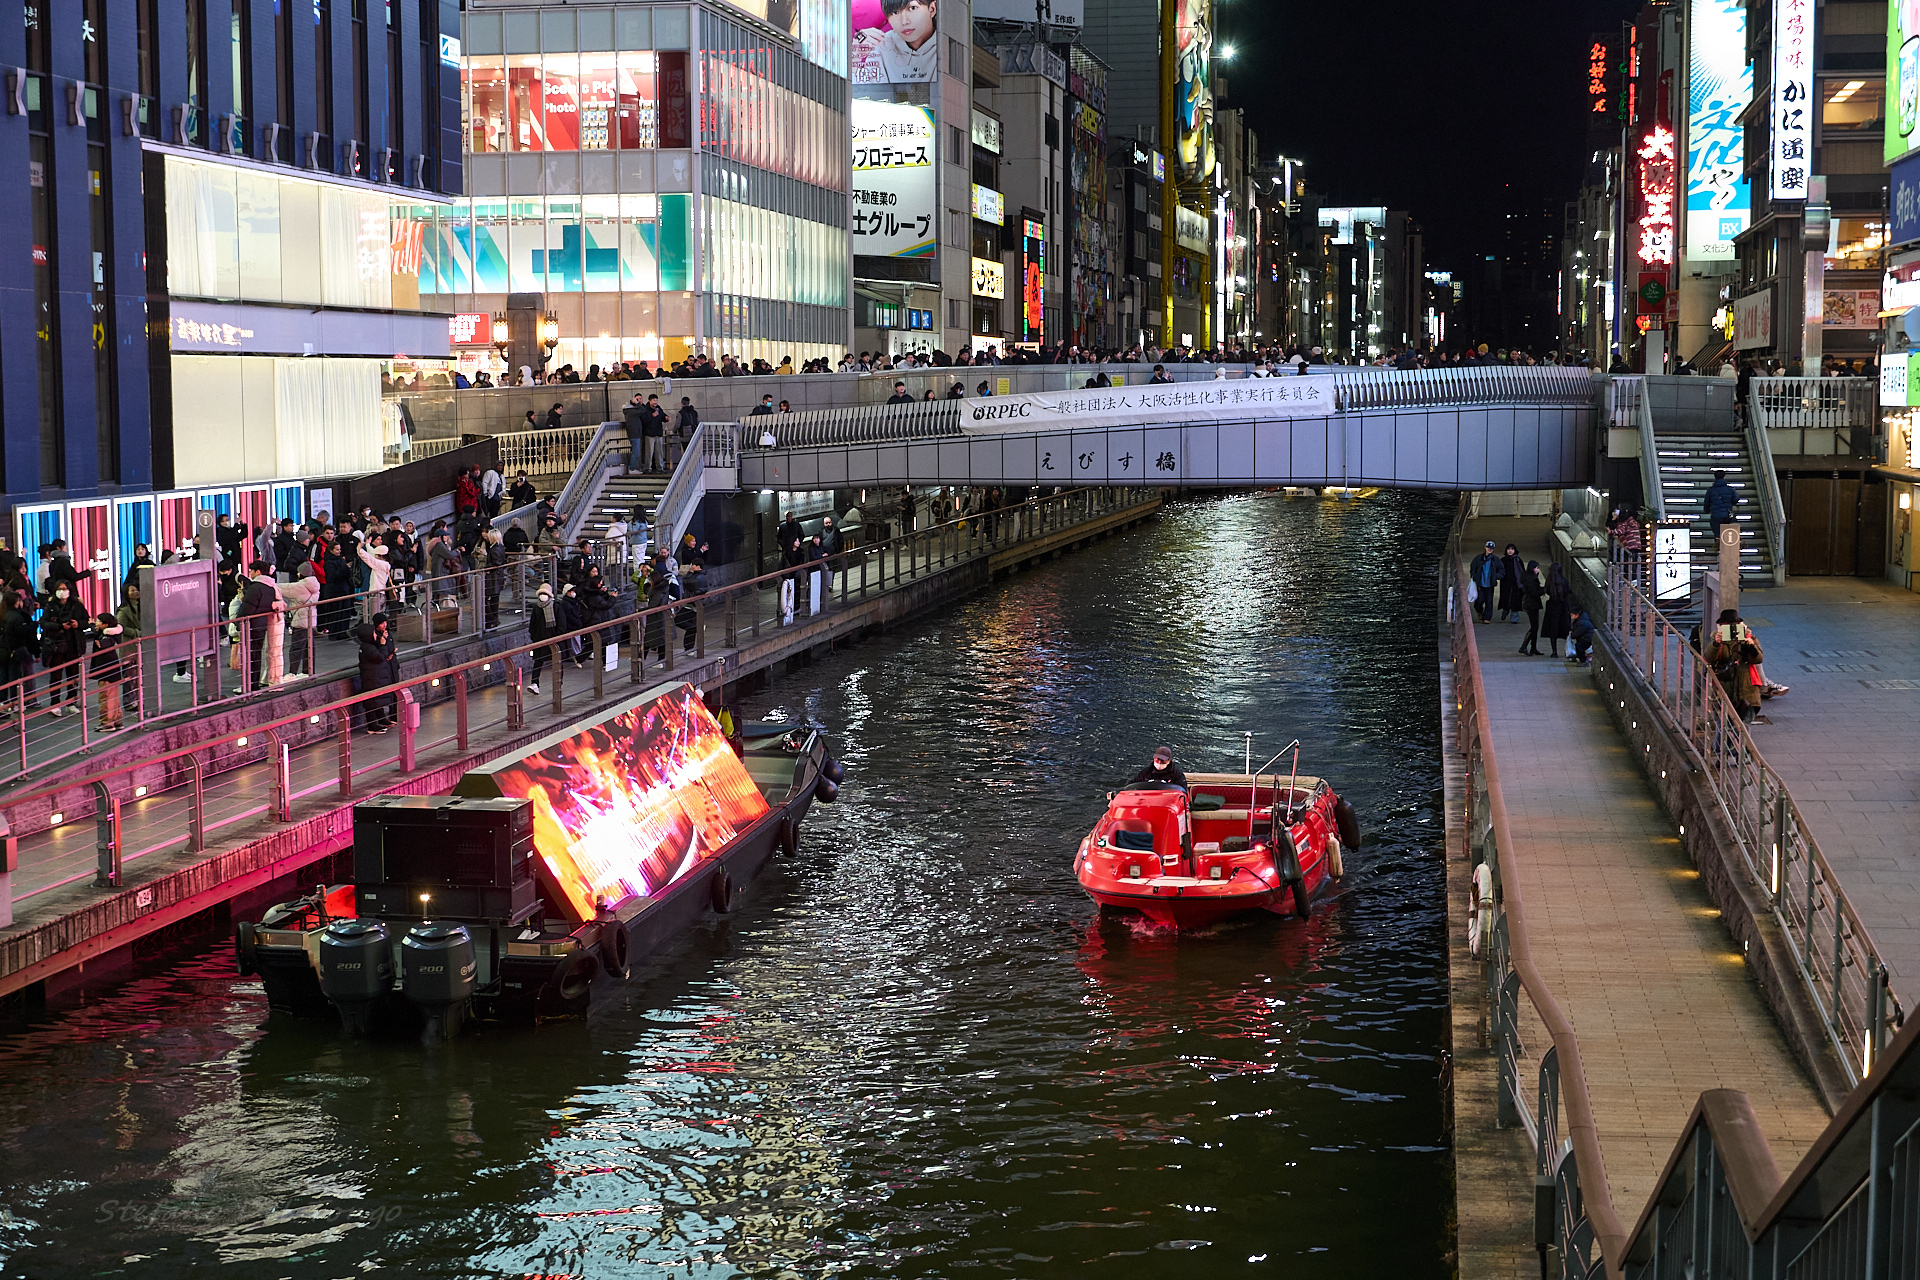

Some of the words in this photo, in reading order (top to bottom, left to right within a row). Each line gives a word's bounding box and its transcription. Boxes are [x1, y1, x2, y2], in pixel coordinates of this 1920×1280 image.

[545, 102, 576, 113] Photo
[1781, 79, 1806, 190] かに道楽
[853, 189, 897, 207] 不動産業の
[853, 209, 931, 239] 士グループ
[1721, 222, 1740, 235] BX
[972, 402, 1032, 421] ORPEC
[1043, 395, 1132, 415] 一般社団法人
[1138, 386, 1320, 409] 大阪活性化事業実行委員会
[1041, 451, 1176, 472] えびす橋
[171, 580, 200, 593] information
[336, 962, 362, 970] 200
[419, 965, 444, 973] 200
